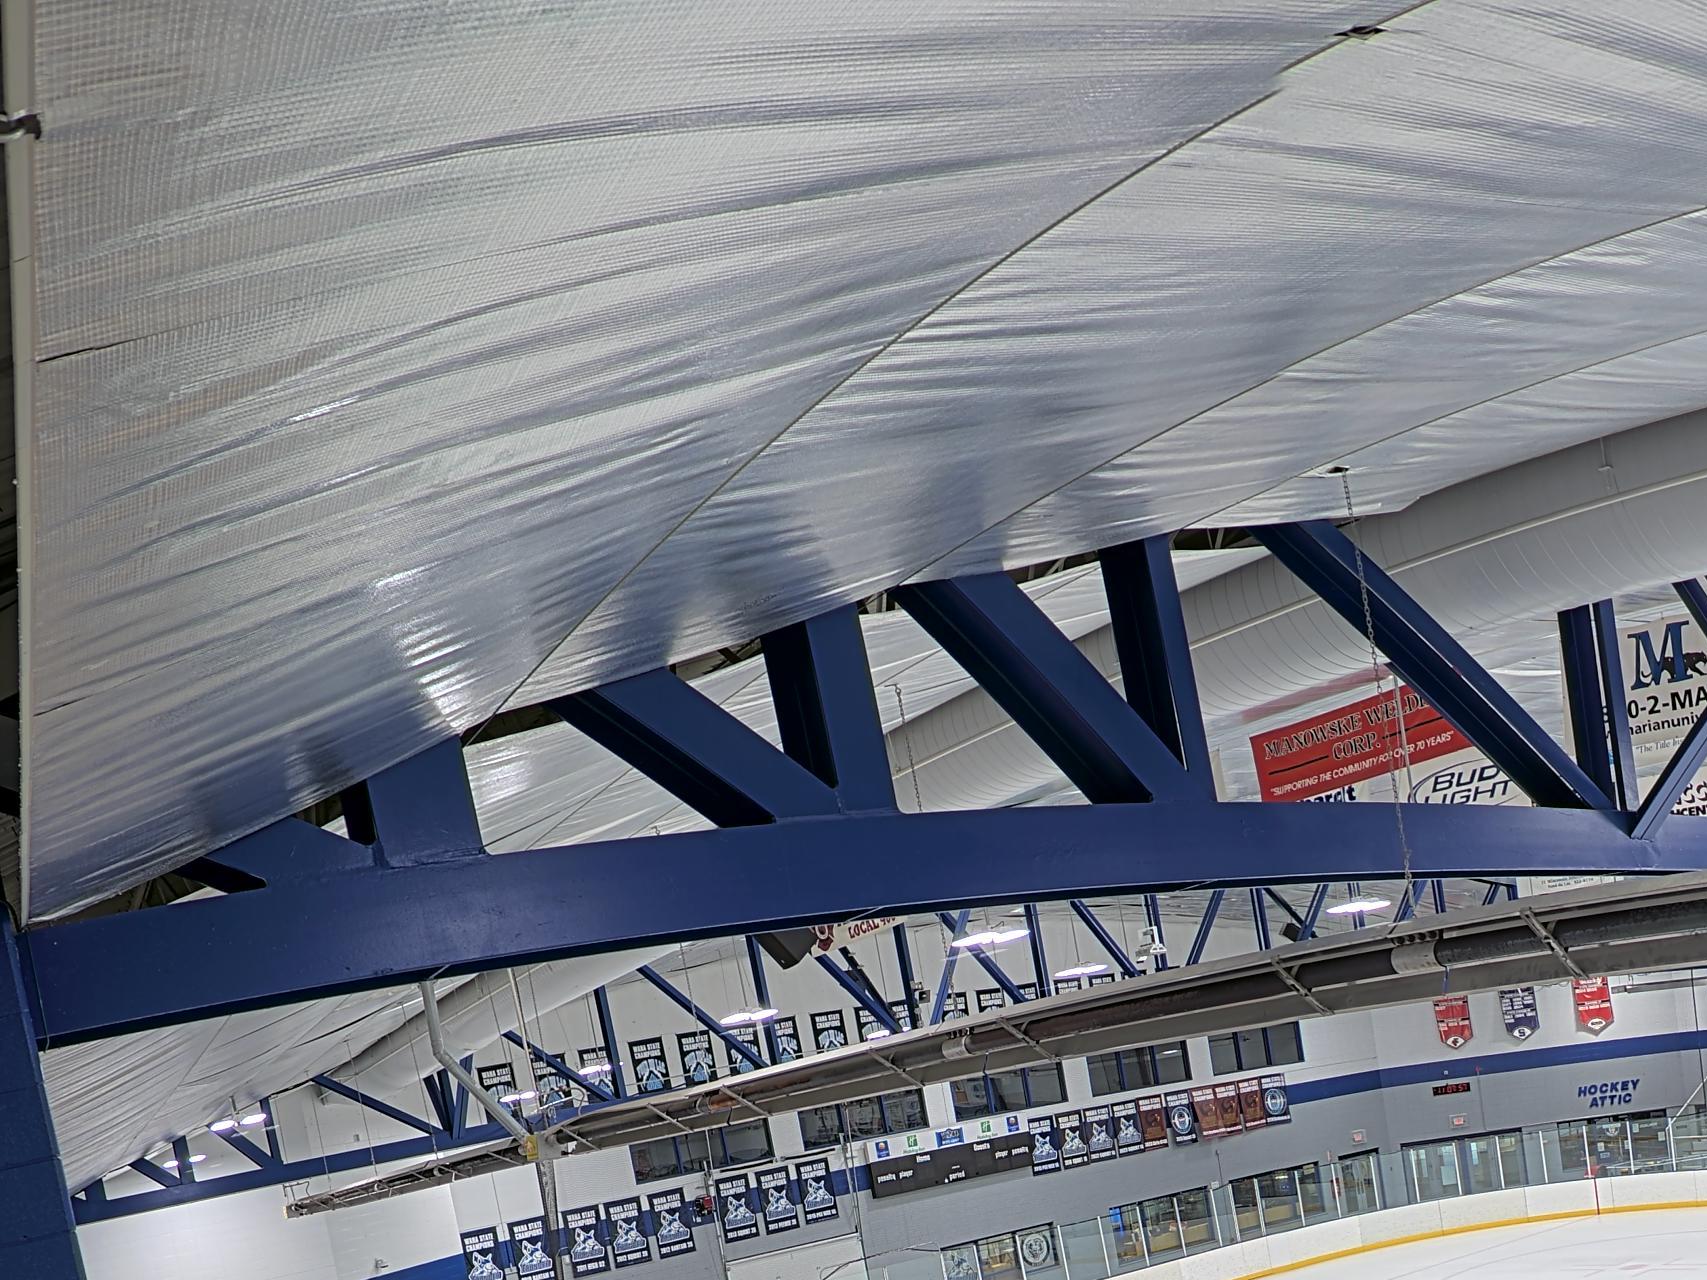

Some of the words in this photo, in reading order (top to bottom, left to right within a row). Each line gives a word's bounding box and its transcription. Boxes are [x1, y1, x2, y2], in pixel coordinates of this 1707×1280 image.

[1264, 713, 1362, 761] MANOWSKE
[1363, 692, 1429, 727] WELDI
[1331, 732, 1381, 761] CORP.
[1319, 771, 1331, 783] THE
[1332, 757, 1378, 779] COMMUNITY
[1415, 741, 1425, 752] 70
[1431, 763, 1502, 793] BUD
[1577, 1078, 1640, 1097] HOCKEY
[1589, 1092, 1633, 1109] ATTIC
